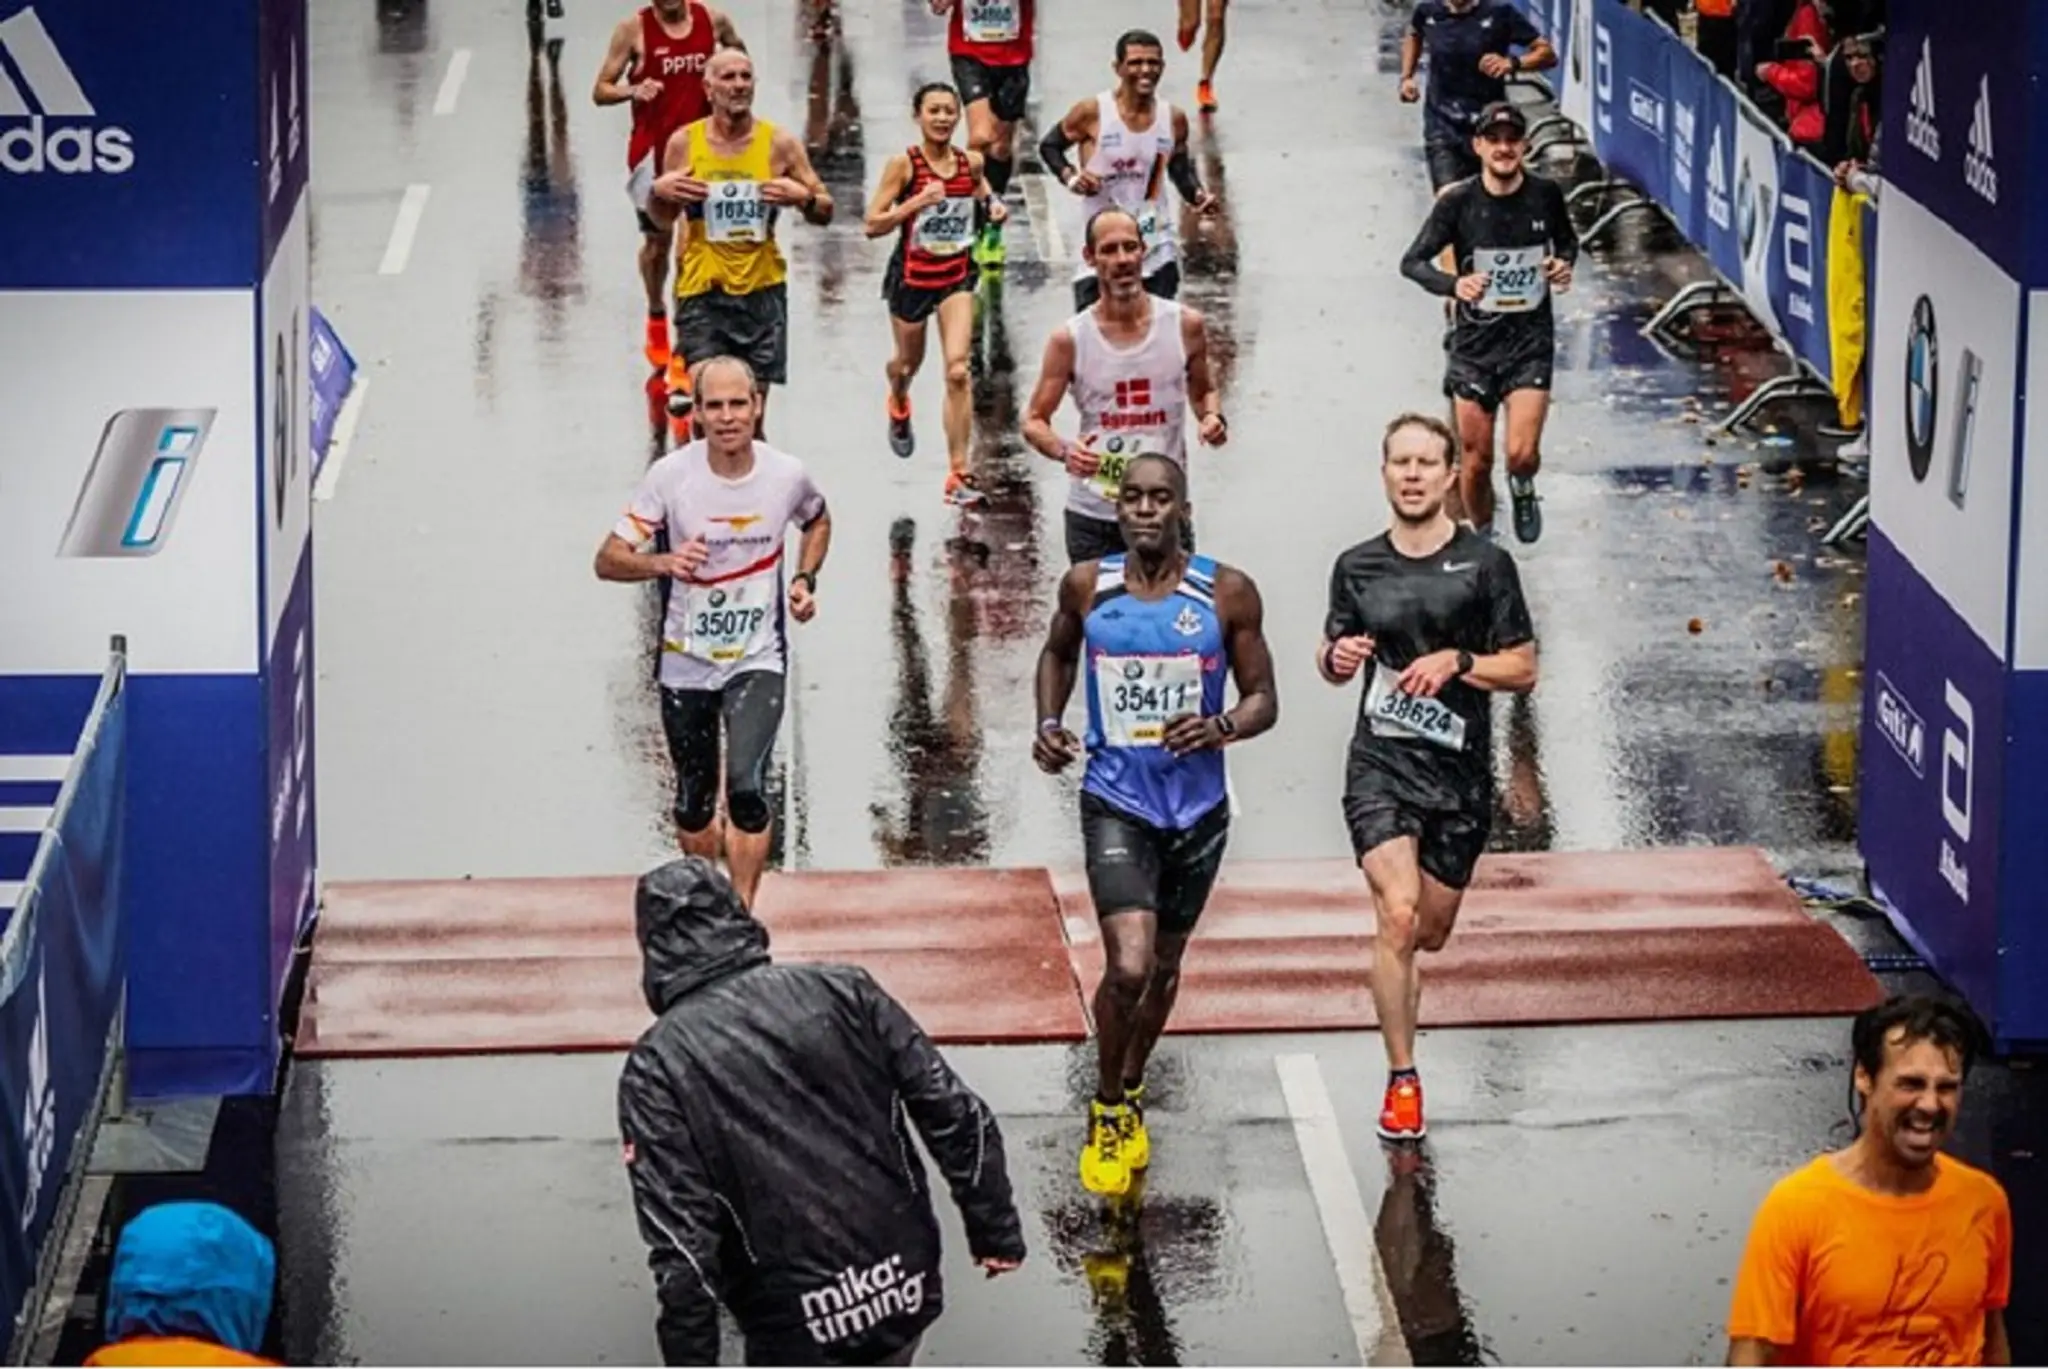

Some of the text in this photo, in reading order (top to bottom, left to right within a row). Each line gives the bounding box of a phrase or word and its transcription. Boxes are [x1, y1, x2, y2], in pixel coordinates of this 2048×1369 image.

[1114, 682, 1187, 712] 35411
[1380, 691, 1452, 735] 38624
[805, 1271, 927, 1344] timing
